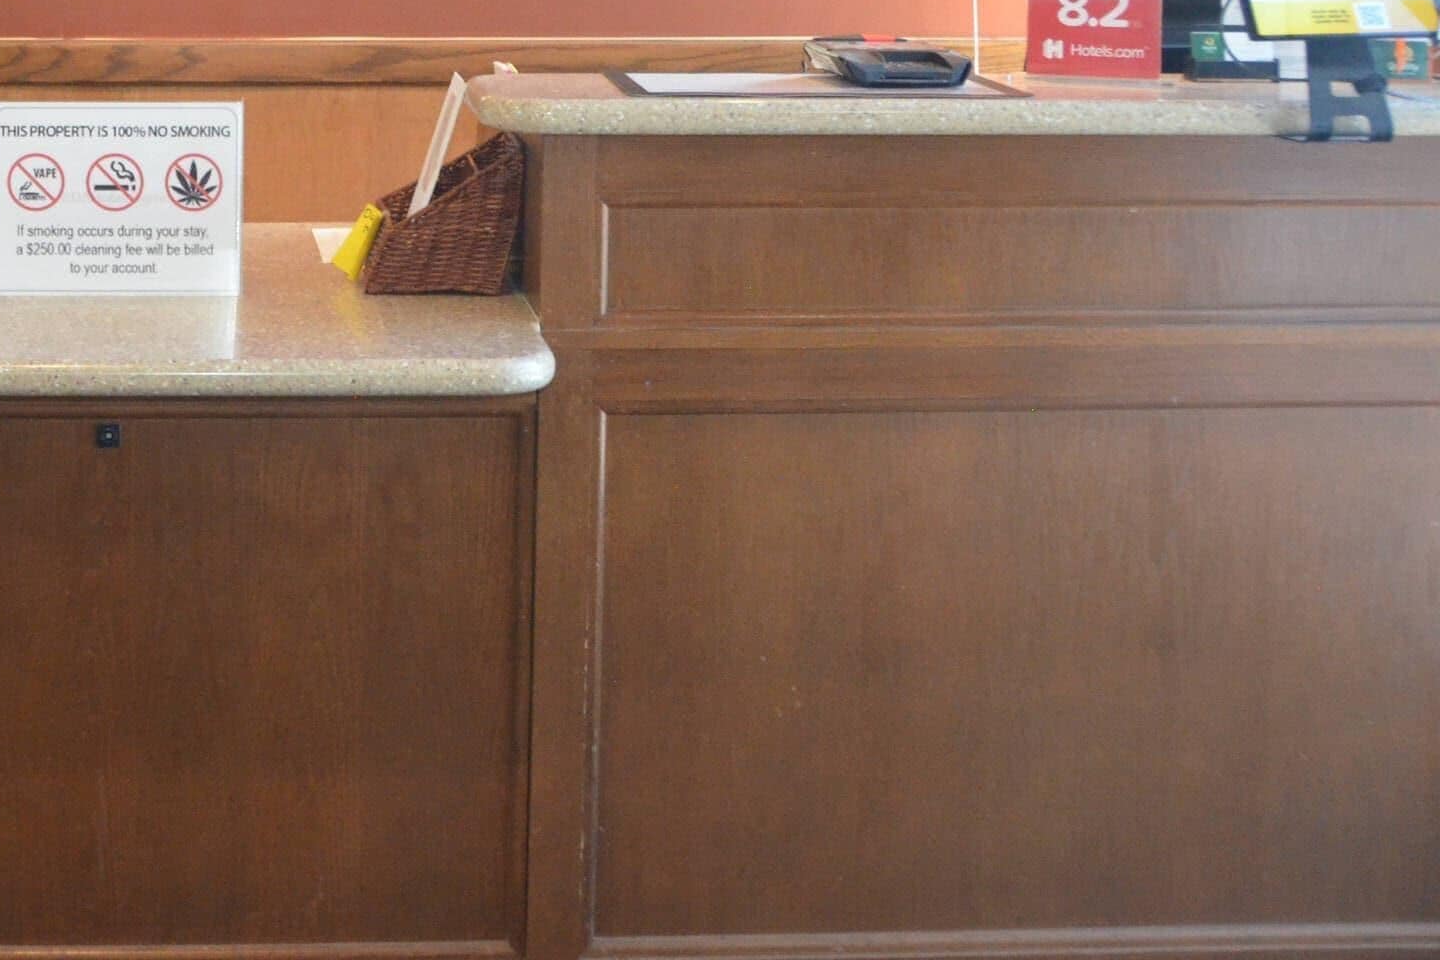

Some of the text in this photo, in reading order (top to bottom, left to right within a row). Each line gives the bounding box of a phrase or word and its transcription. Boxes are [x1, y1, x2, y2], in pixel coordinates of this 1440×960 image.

[1070, 43, 1145, 58] Hotels.com
[0, 125, 231, 138] THIS PROPERTY IS 100% NO SMOKING
[33, 168, 57, 179] VAPE
[17, 225, 24, 237] If
[27, 225, 74, 240] smoking
[77, 228, 114, 238] occurs
[117, 225, 152, 240] during
[156, 228, 179, 240] your
[16, 242, 214, 258] a $250.00 cleaning fee will be billed
[70, 263, 81, 274] to
[84, 264, 108, 276] your
